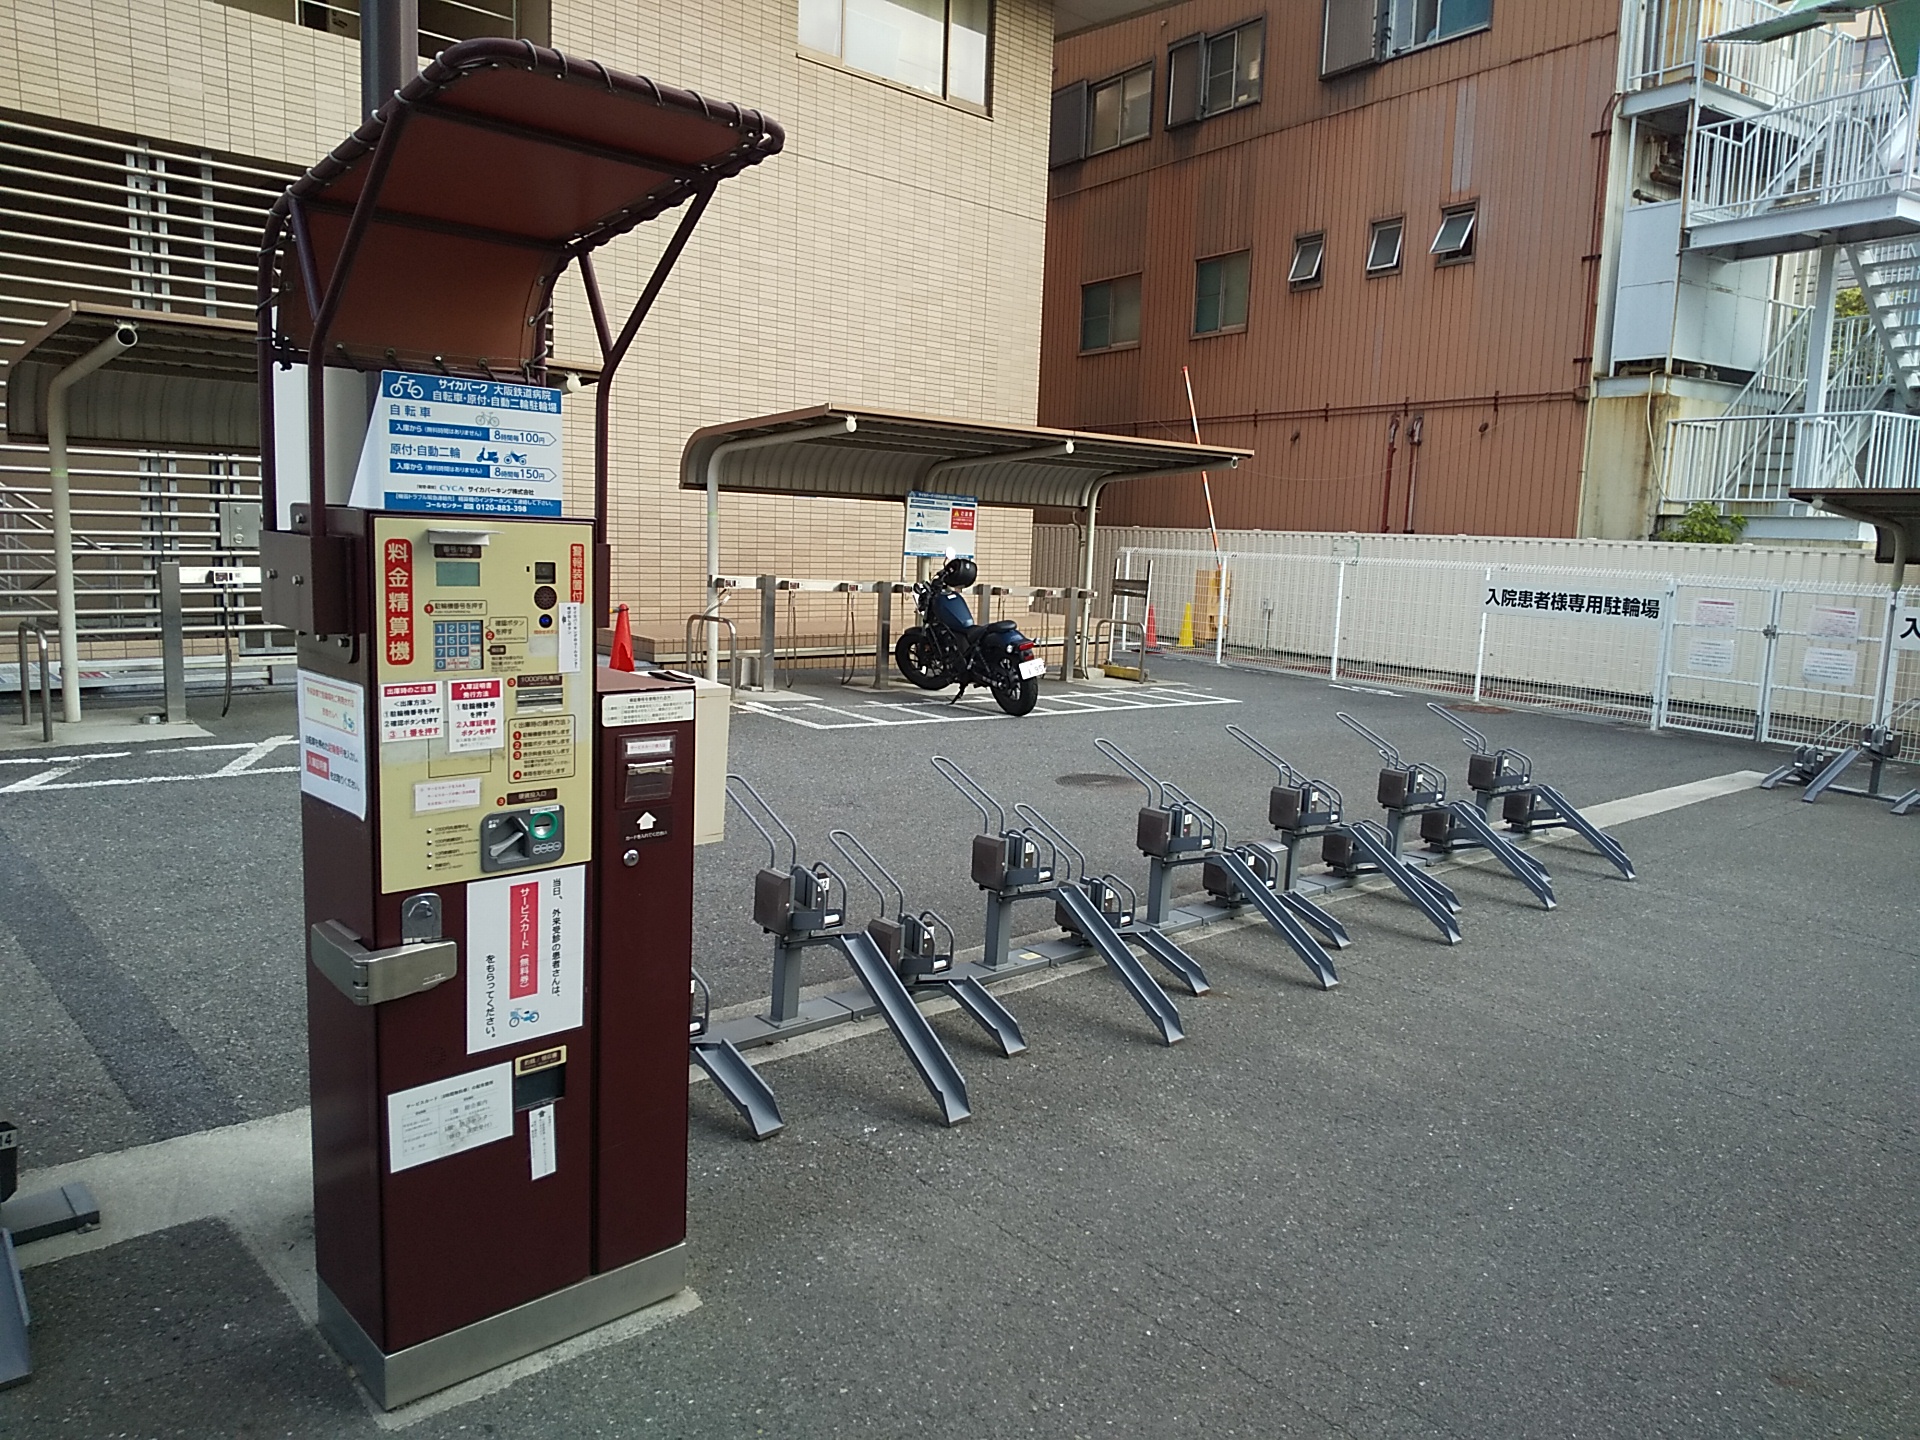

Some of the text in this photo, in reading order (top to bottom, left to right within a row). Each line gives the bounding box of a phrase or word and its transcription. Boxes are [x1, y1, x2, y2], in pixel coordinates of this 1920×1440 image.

[438, 379, 552, 401] サイカパーク 大阪鉄道病院
[432, 390, 558, 413] 自転車・原付・自動二輪駐輪場
[390, 403, 431, 418] 自転車
[395, 423, 423, 433] 入庫から
[390, 443, 461, 459] 原付・自動二輪
[395, 462, 423, 471] 入庫から
[467, 485, 535, 496] サイカパーキング株式会社
[425, 501, 528, 513] コールセンター 0120-883-398
[387, 542, 411, 662] 料金精算機
[1484, 588, 1661, 619] 入院患者様専用駐輪場
[495, 628, 513, 636] を押す
[386, 685, 435, 695] 出庫時のご注意
[459, 682, 493, 691] 入庫証明書
[462, 690, 490, 699] 発行方法
[470, 710, 488, 718] を押す
[460, 727, 498, 737] ボタンを押す
[519, 887, 531, 989] サービスカード（無料券）
[551, 878, 563, 997] 当日、 外来受診の患者さんは、
[485, 954, 496, 1039] をもらってください。
